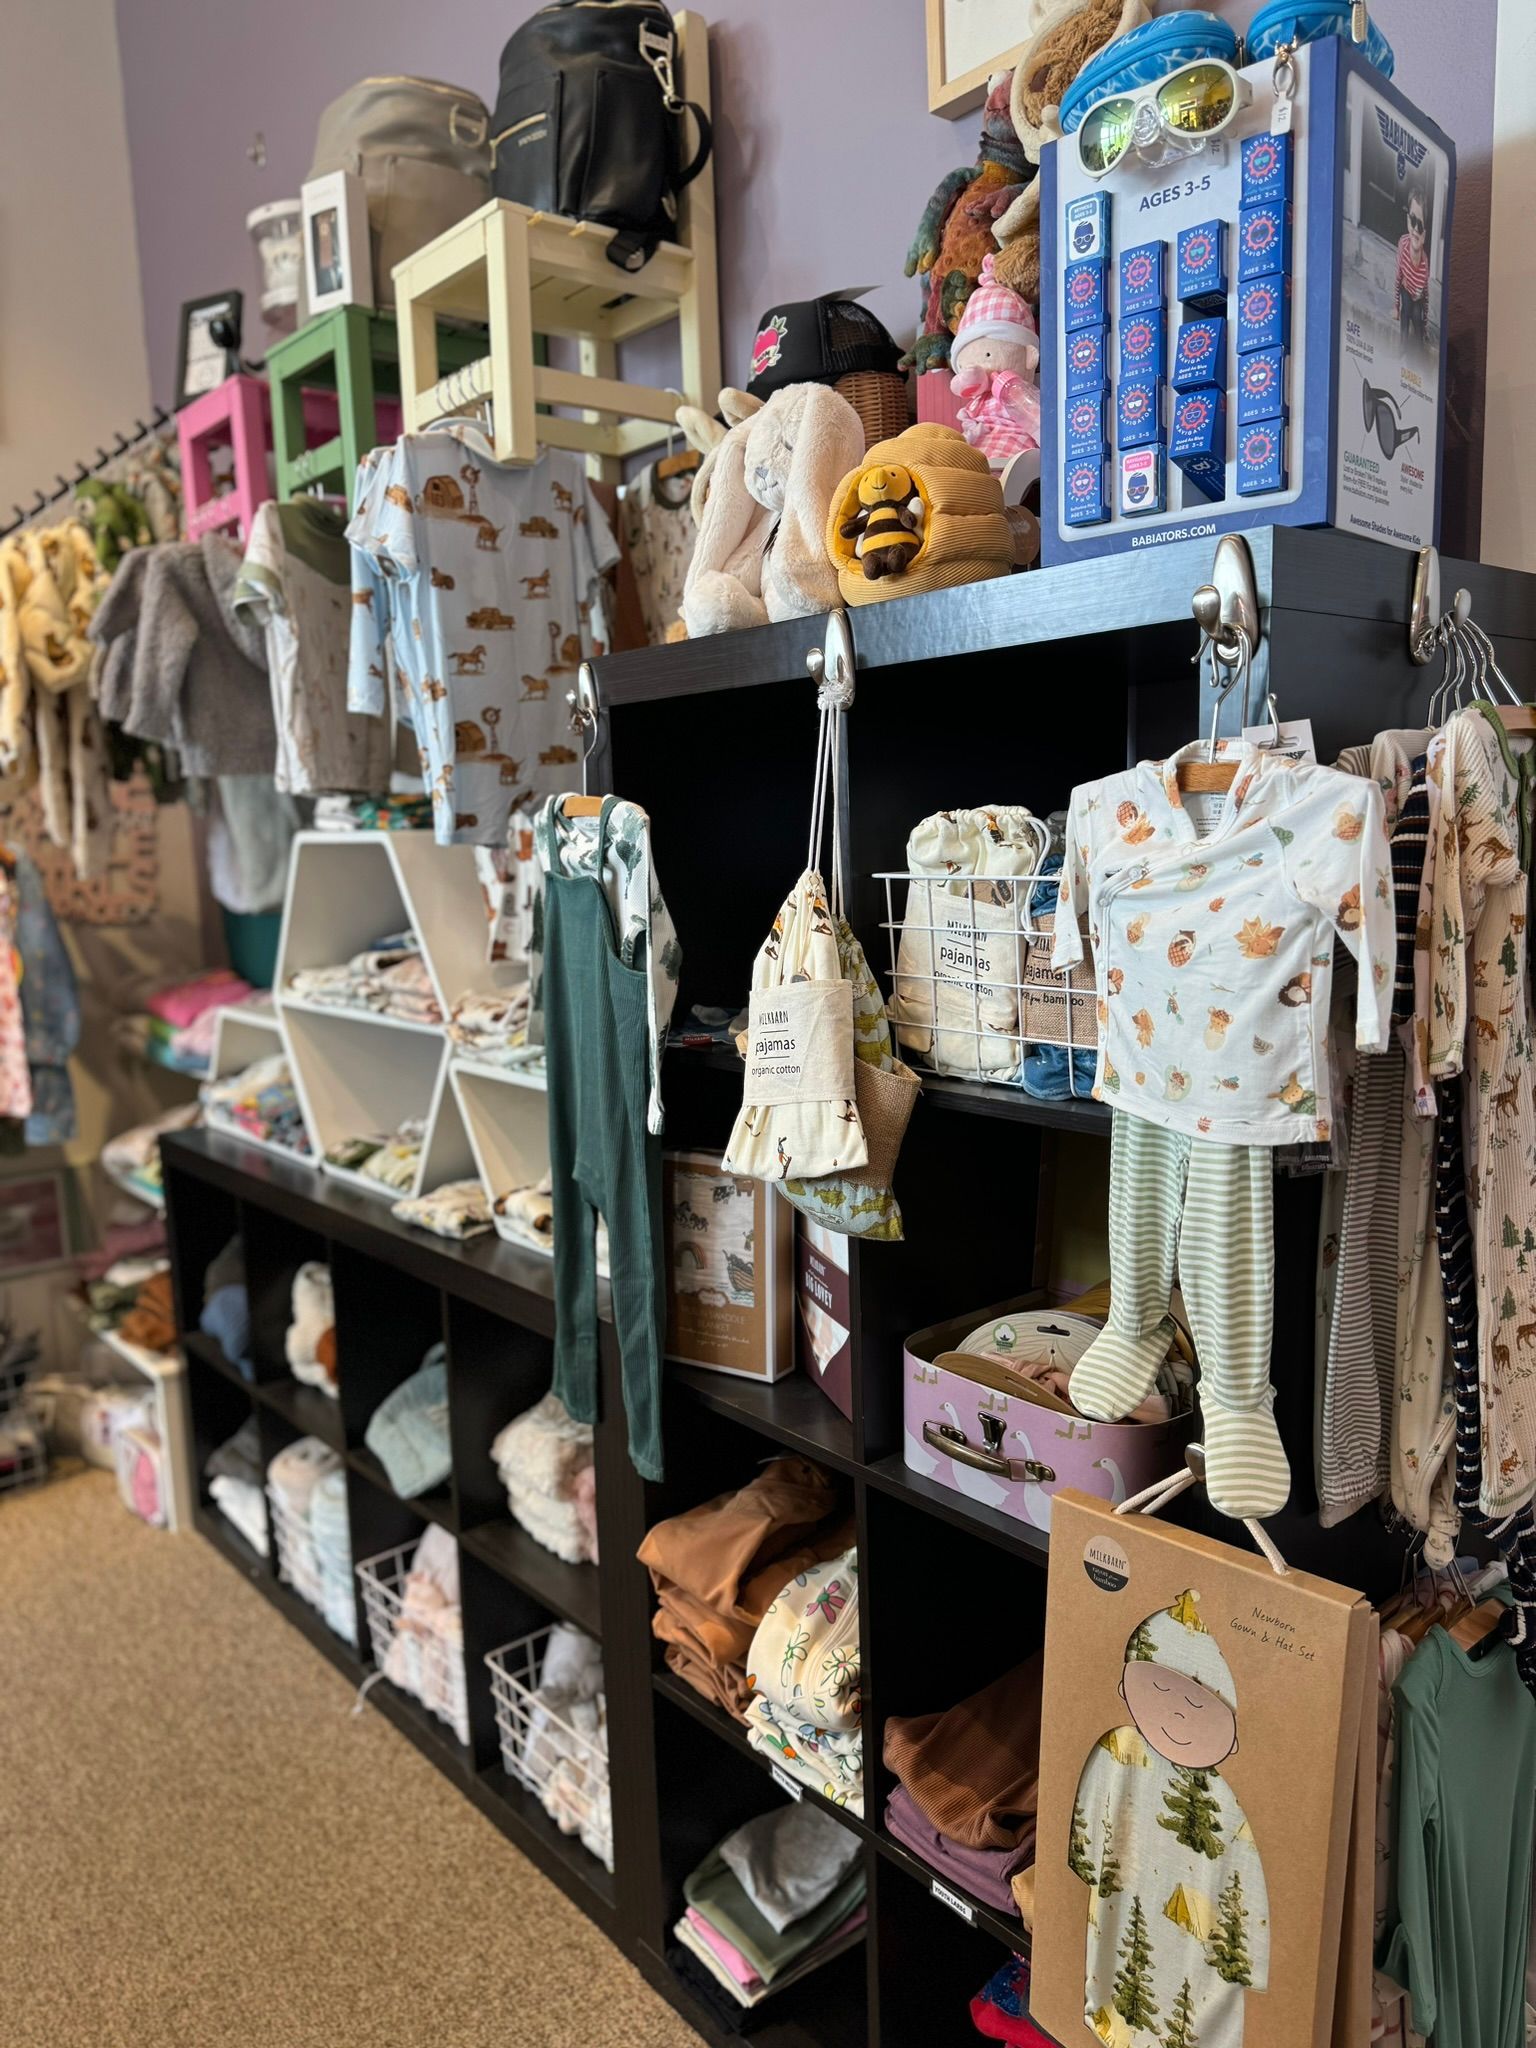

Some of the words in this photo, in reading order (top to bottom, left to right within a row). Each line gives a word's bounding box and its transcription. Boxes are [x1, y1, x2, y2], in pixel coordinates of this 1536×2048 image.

[1139, 185, 1181, 212] AGES
[1185, 175, 1212, 196] 3-5
[1131, 523, 1217, 547] BABIATORS.COM
[947, 920, 988, 943] MILKBRN
[751, 1065, 775, 1078] organic
[776, 1065, 801, 1075] cotton
[1251, 1607, 1297, 1633] Newborn
[1230, 1617, 1257, 1637] Gown
[1261, 1631, 1270, 1643] &
[1275, 1636, 1294, 1653] Hat
[1298, 1645, 1316, 1662] Set
